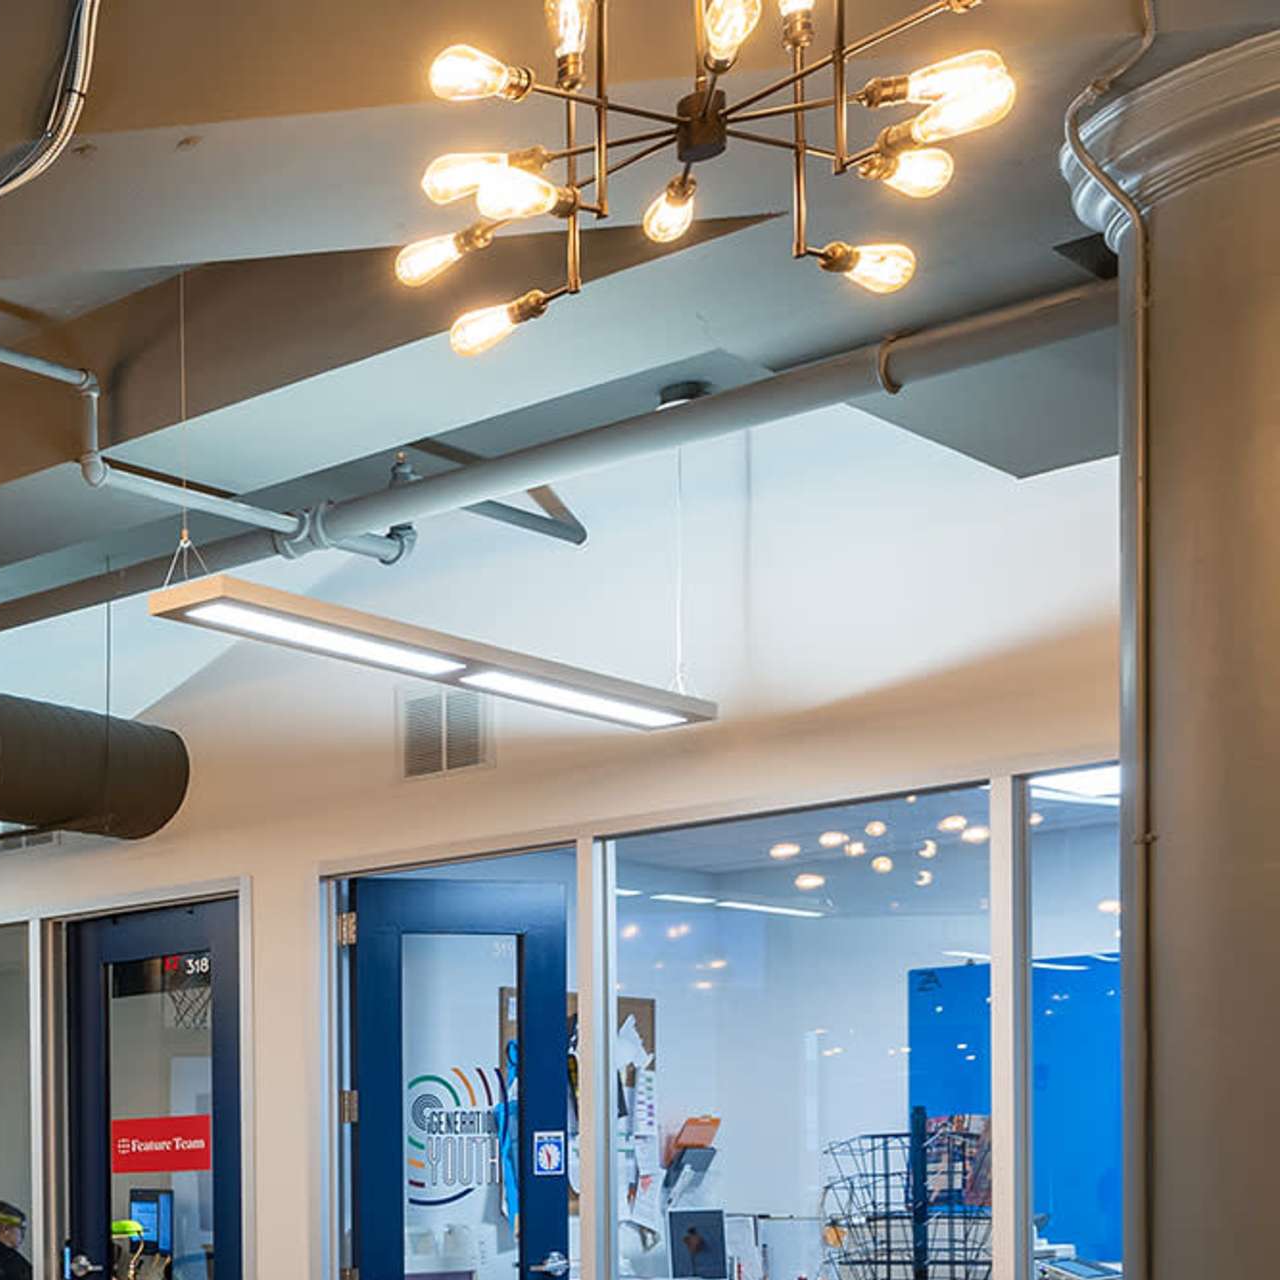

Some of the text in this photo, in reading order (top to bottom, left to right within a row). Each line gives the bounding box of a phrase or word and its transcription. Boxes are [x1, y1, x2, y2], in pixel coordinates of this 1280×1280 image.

[184, 957, 209, 975] 318
[131, 1136, 205, 1152] Feature Team
[427, 1136, 499, 1186] YOUTH
